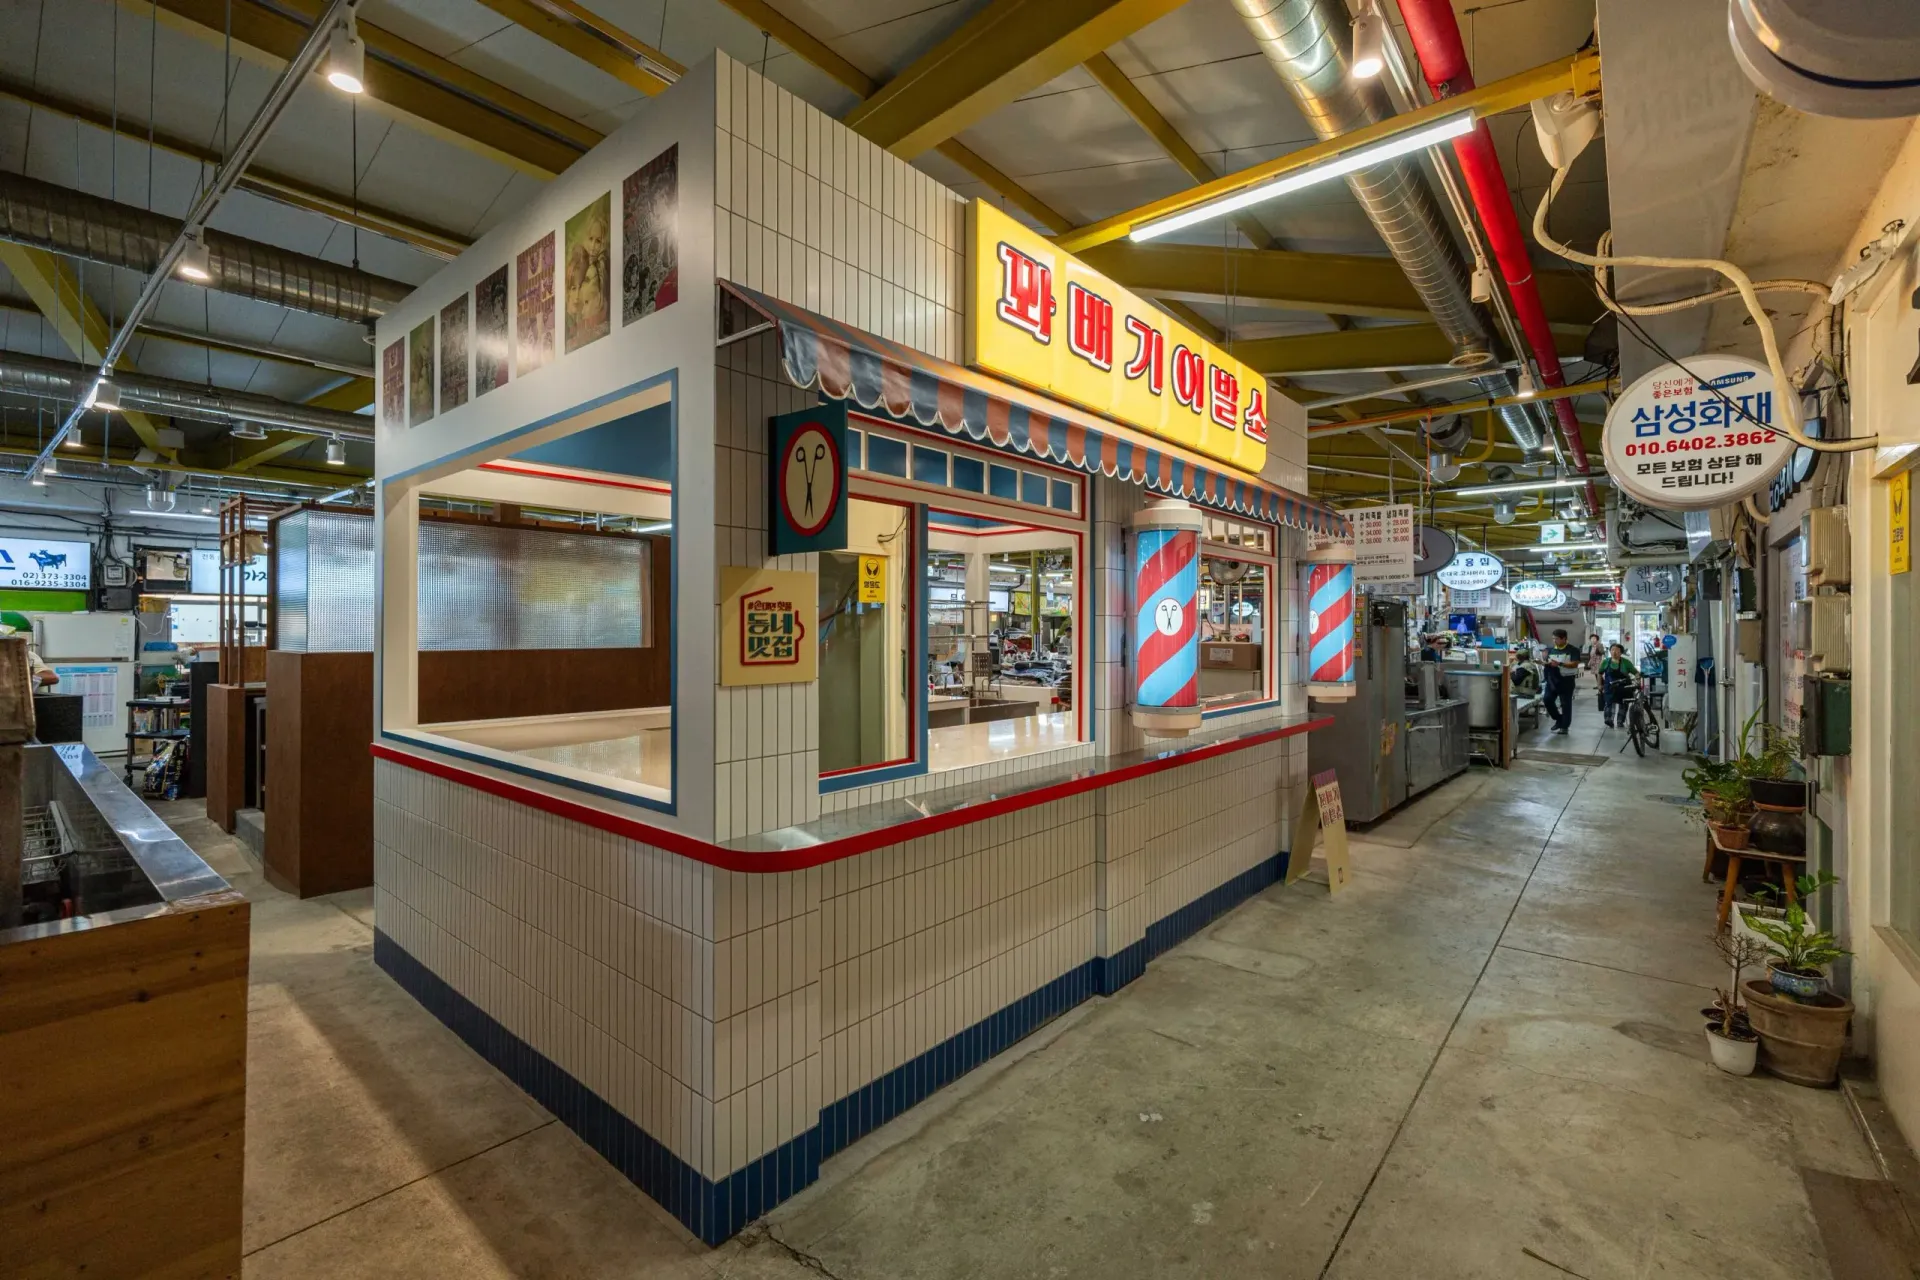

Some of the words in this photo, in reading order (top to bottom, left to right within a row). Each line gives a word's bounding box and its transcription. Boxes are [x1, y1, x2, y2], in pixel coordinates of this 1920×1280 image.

[1653, 378, 1693, 390] 당신에게
[1706, 376, 1750, 388] AMSUNG
[1653, 387, 1693, 399] 좋은보험
[1631, 391, 1771, 437] 삼성화재
[1625, 430, 1776, 457] 010.6402.3862
[1637, 461, 1667, 475] 모든
[1671, 459, 1702, 472] 보험
[1707, 455, 1741, 469] 상담
[1746, 453, 1762, 466] 해
[1661, 472, 1734, 488] 드립니다!
[11, 579, 87, 588] 016-9235-3304
[1636, 581, 1671, 595] 네일
[747, 612, 793, 635] 동네
[1676, 657, 1688, 689] 소화기
